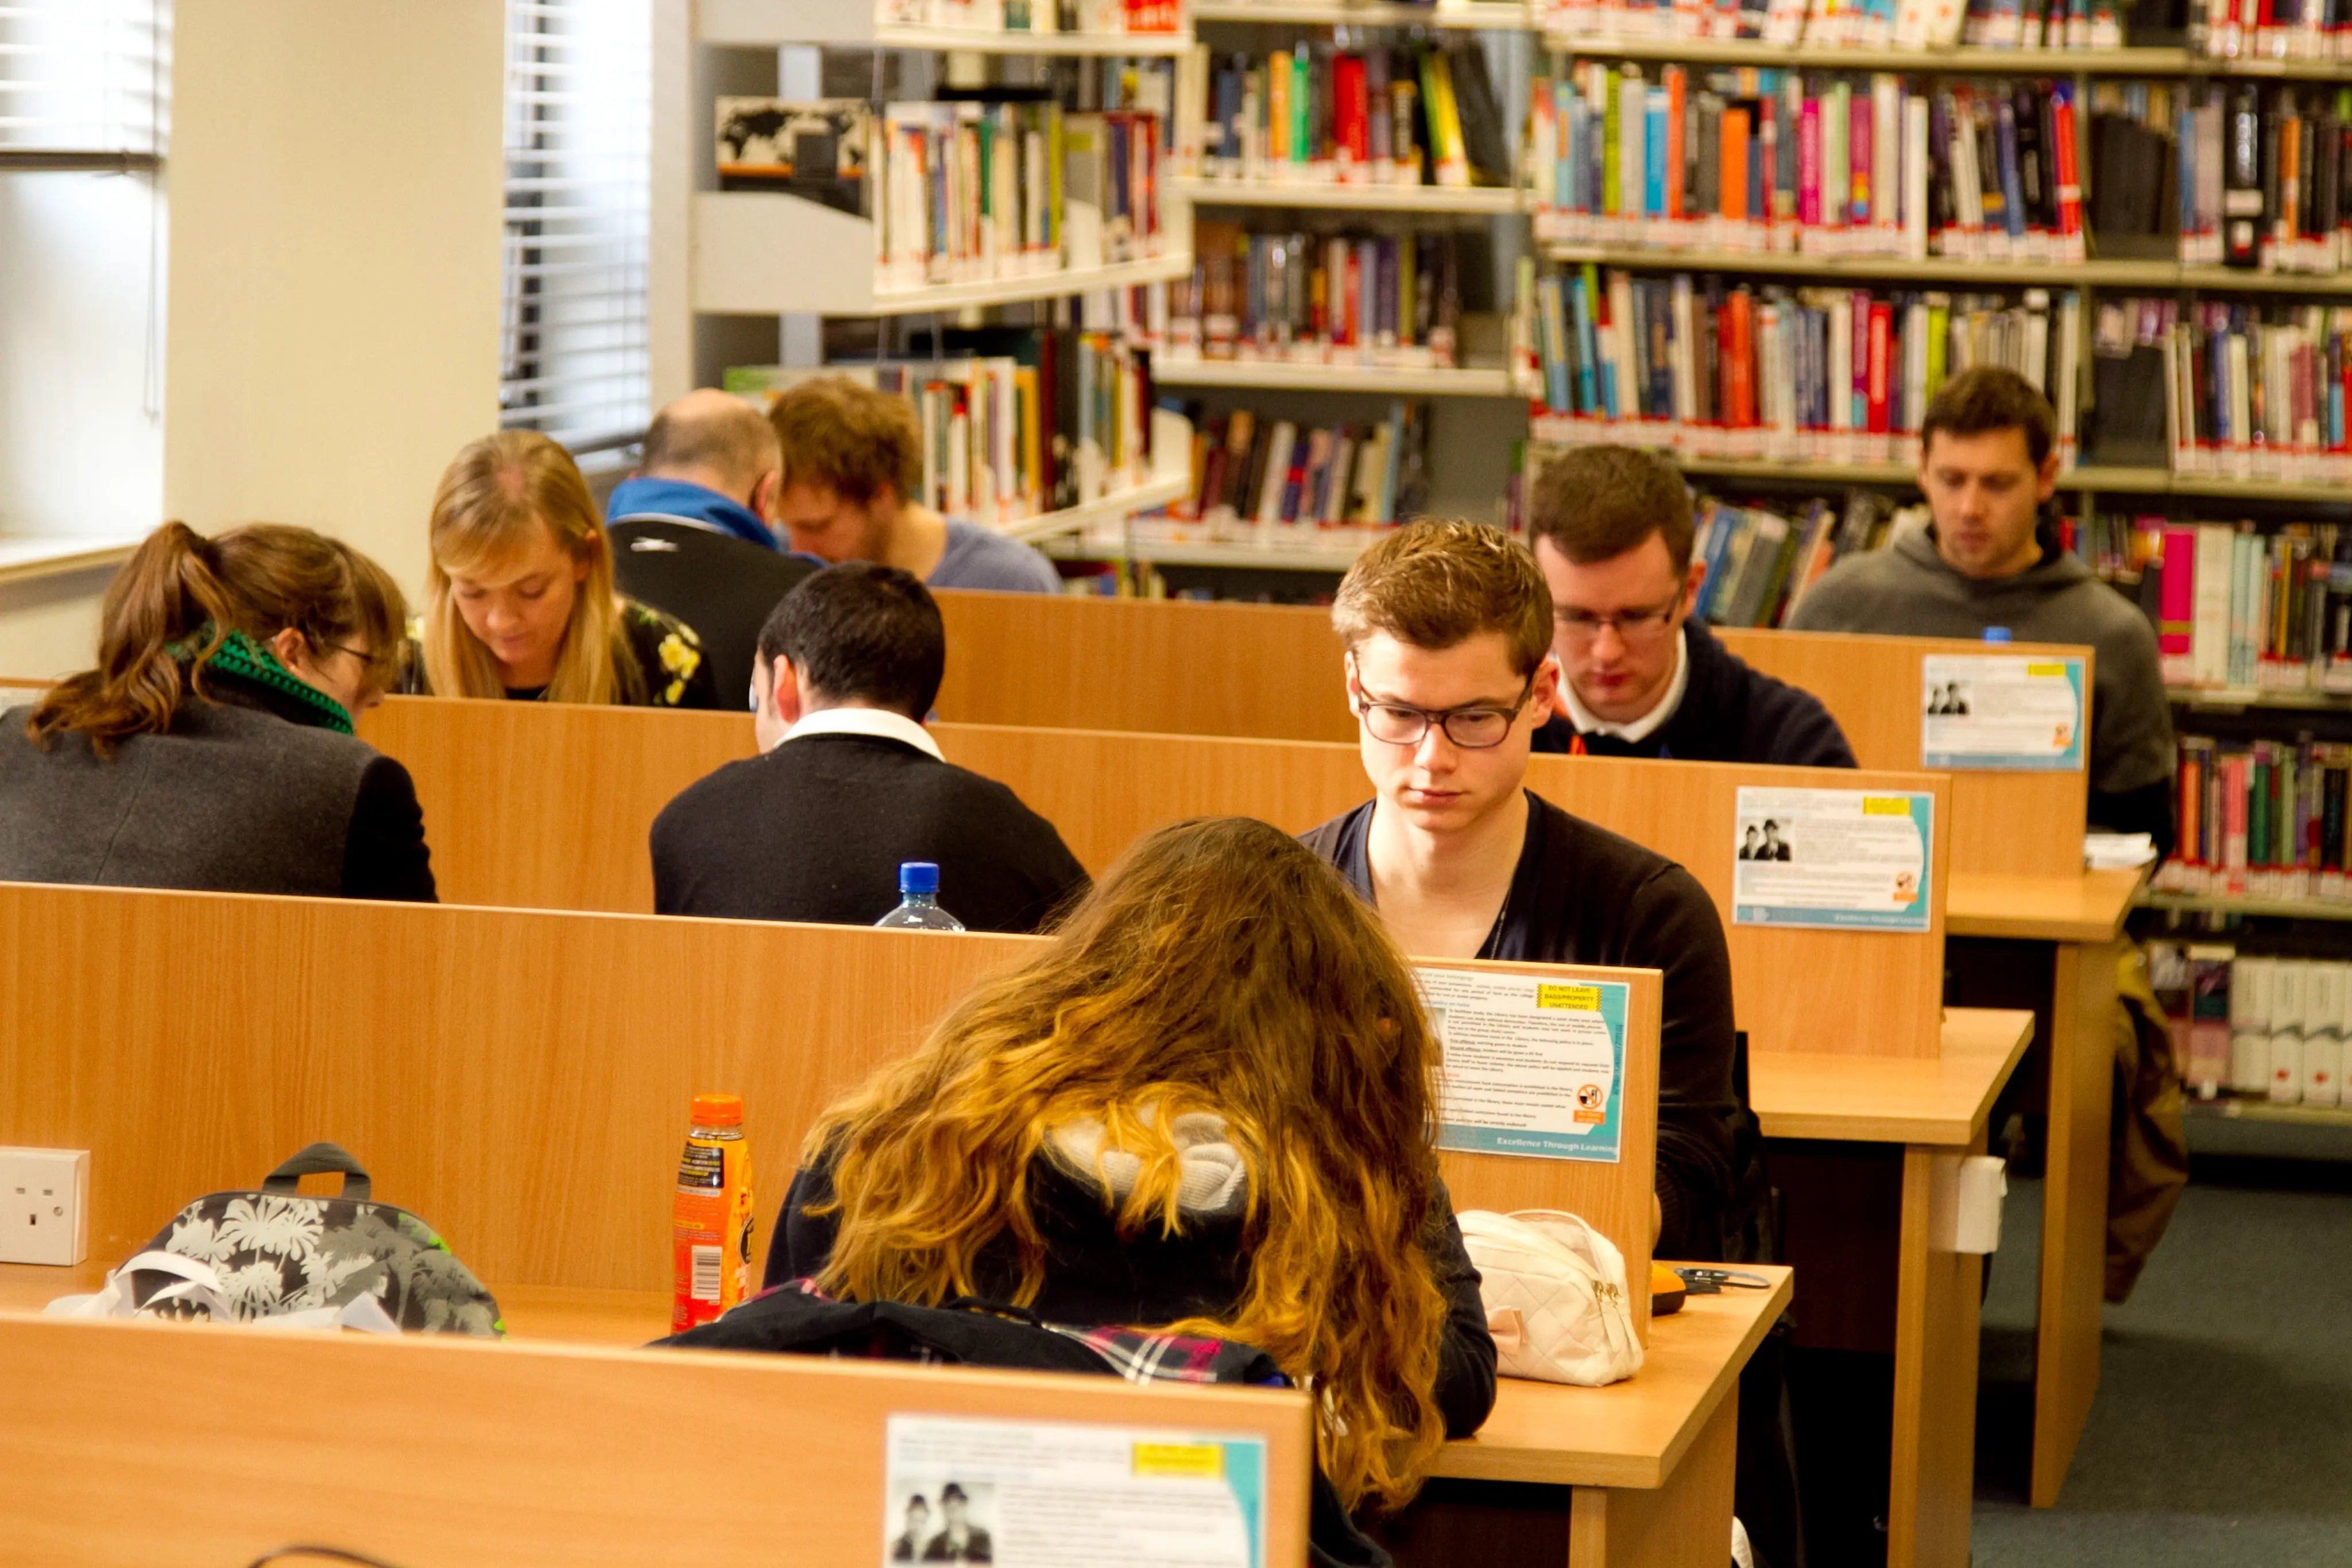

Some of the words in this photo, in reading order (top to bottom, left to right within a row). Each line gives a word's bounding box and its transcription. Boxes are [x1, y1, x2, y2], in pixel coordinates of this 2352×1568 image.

[1545, 994, 1594, 1002] BAGS/PROPERTY
[1549, 1002, 1588, 1011] UNATTENDED
[1497, 1138, 1541, 1148] Excellence
[1544, 1140, 1579, 1152] Through
[1581, 1143, 1618, 1156] Learning
